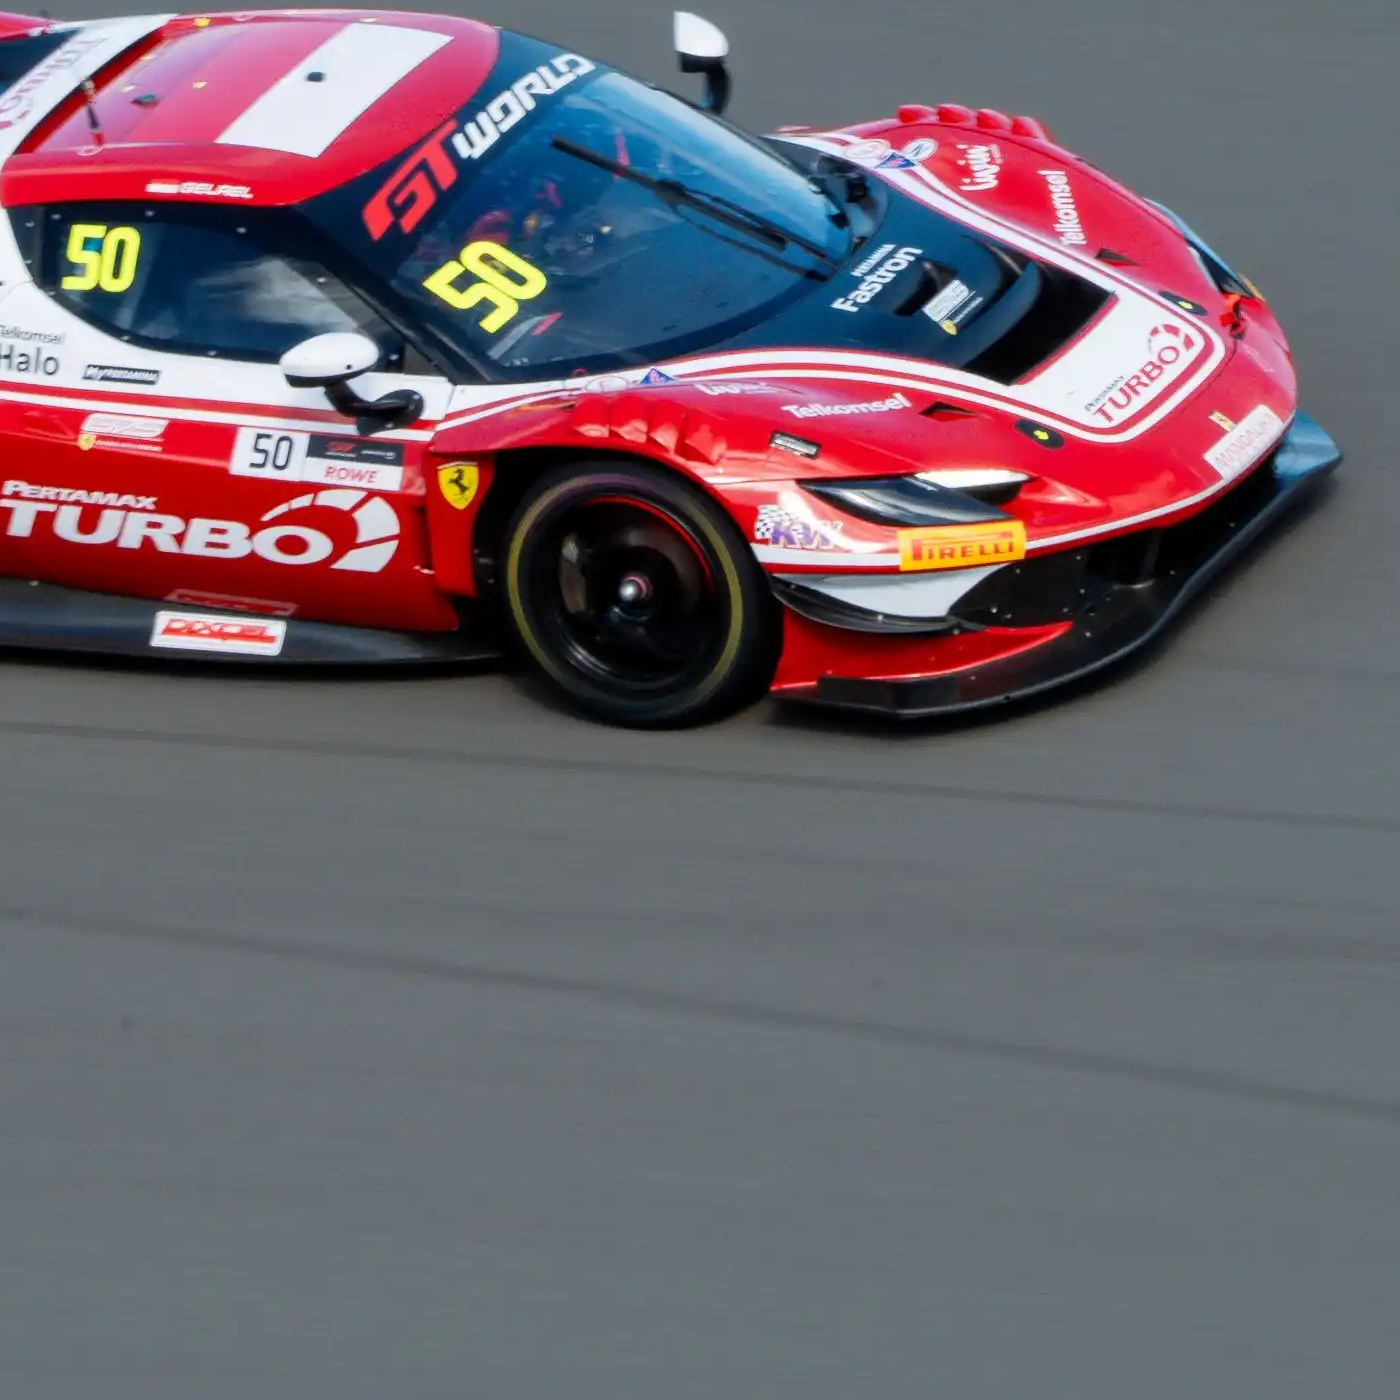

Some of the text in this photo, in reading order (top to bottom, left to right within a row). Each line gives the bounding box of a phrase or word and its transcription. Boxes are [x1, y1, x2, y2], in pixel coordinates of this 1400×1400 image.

[362, 53, 596, 241] GT WORLD
[1037, 170, 1088, 245] Telkomsel
[61, 224, 141, 293] 50
[423, 240, 547, 334] 50
[831, 246, 924, 313] Fastron
[781, 392, 912, 419] Telkomsel
[1094, 345, 1180, 423] TURBO
[249, 432, 293, 471] 50
[324, 465, 380, 484] ROWE
[1, 480, 158, 511] PERTAMAX
[911, 531, 1014, 561] PIRELLI
